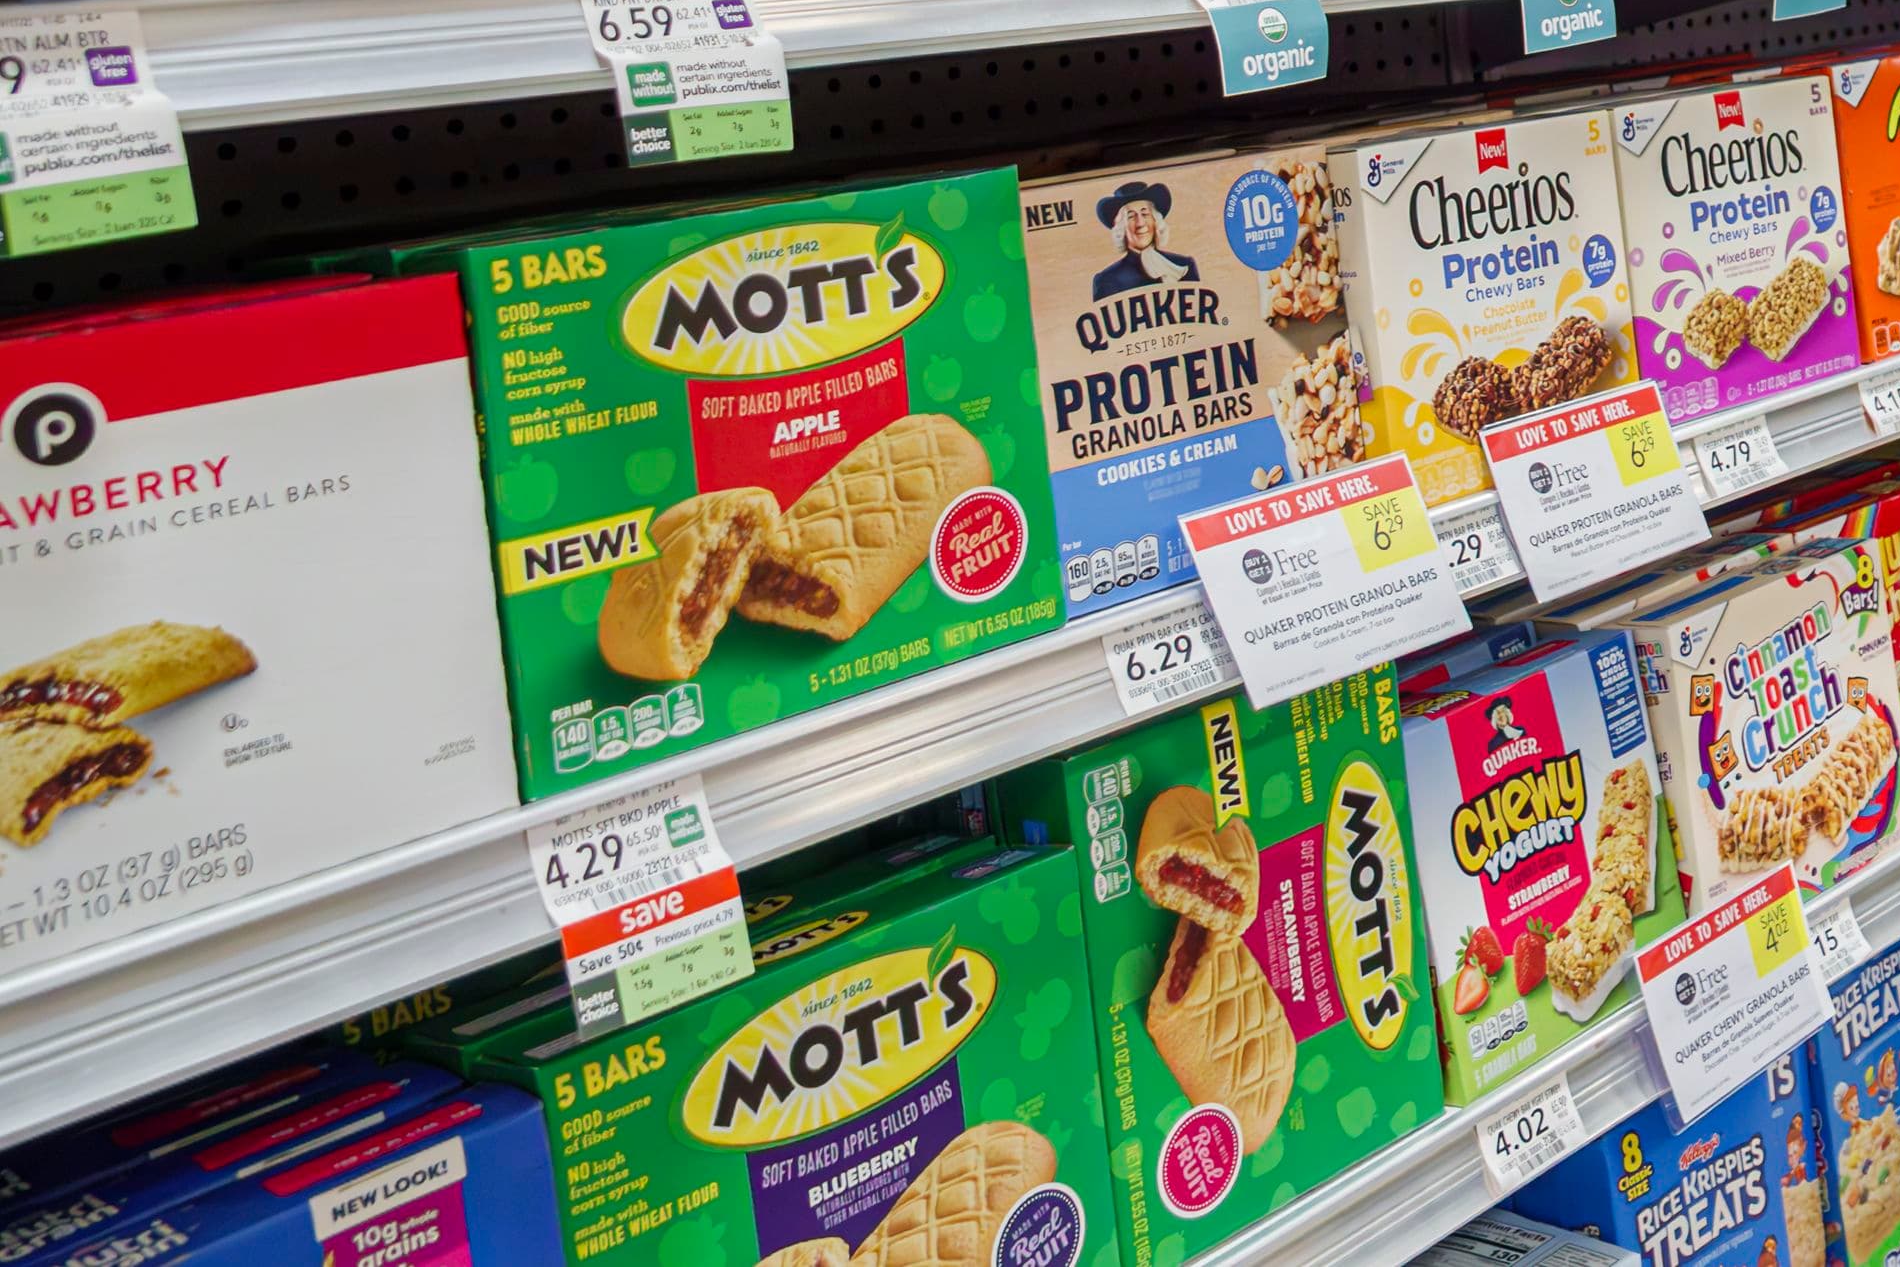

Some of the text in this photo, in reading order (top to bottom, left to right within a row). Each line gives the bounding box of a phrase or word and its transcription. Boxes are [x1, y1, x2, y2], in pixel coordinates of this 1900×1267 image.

[600, 6, 674, 42] 6.59
[1541, 5, 1603, 38] organic
[1243, 40, 1315, 80] organic
[682, 80, 781, 99] publix.com/thelist
[632, 127, 667, 141] better
[632, 140, 670, 153] choice
[1661, 118, 1803, 198] Cheerios
[1025, 200, 1075, 228] NEW
[1409, 162, 1575, 250] Cheerios
[1690, 186, 1791, 232] Protein
[1709, 219, 1779, 246] Chewy Bars
[1715, 242, 1776, 268] Mixed Berry
[491, 244, 607, 293] 5 BARS
[1075, 288, 1220, 352] QUAKER
[1052, 339, 1259, 432] PROTEIN
[1072, 392, 1254, 460] GRANOLA BARS
[1515, 399, 1635, 450] LOVE TO SAVE HERE.
[1096, 434, 1238, 486] COOKIES & CREAM
[1711, 440, 1751, 474] 4.79
[1225, 475, 1379, 535] LOVE TO SAVE HERE.
[1362, 497, 1402, 522] SAVE
[524, 520, 639, 582] NEW!
[1856, 555, 1874, 590] 8
[1243, 568, 1438, 645] QUAKER PROTEIN GRANOLA BARS
[1843, 586, 1881, 616] Bars!
[1751, 644, 1823, 718] Toast
[1744, 675, 1842, 771] Crunch
[545, 834, 624, 889] 4.29
[620, 890, 684, 934] save
[1664, 886, 1772, 963] LOVE TO SAVE HERE.
[578, 940, 644, 974] Save 50¢
[555, 1035, 667, 1109] 5 BARS
[1493, 1107, 1548, 1157] 4.02
